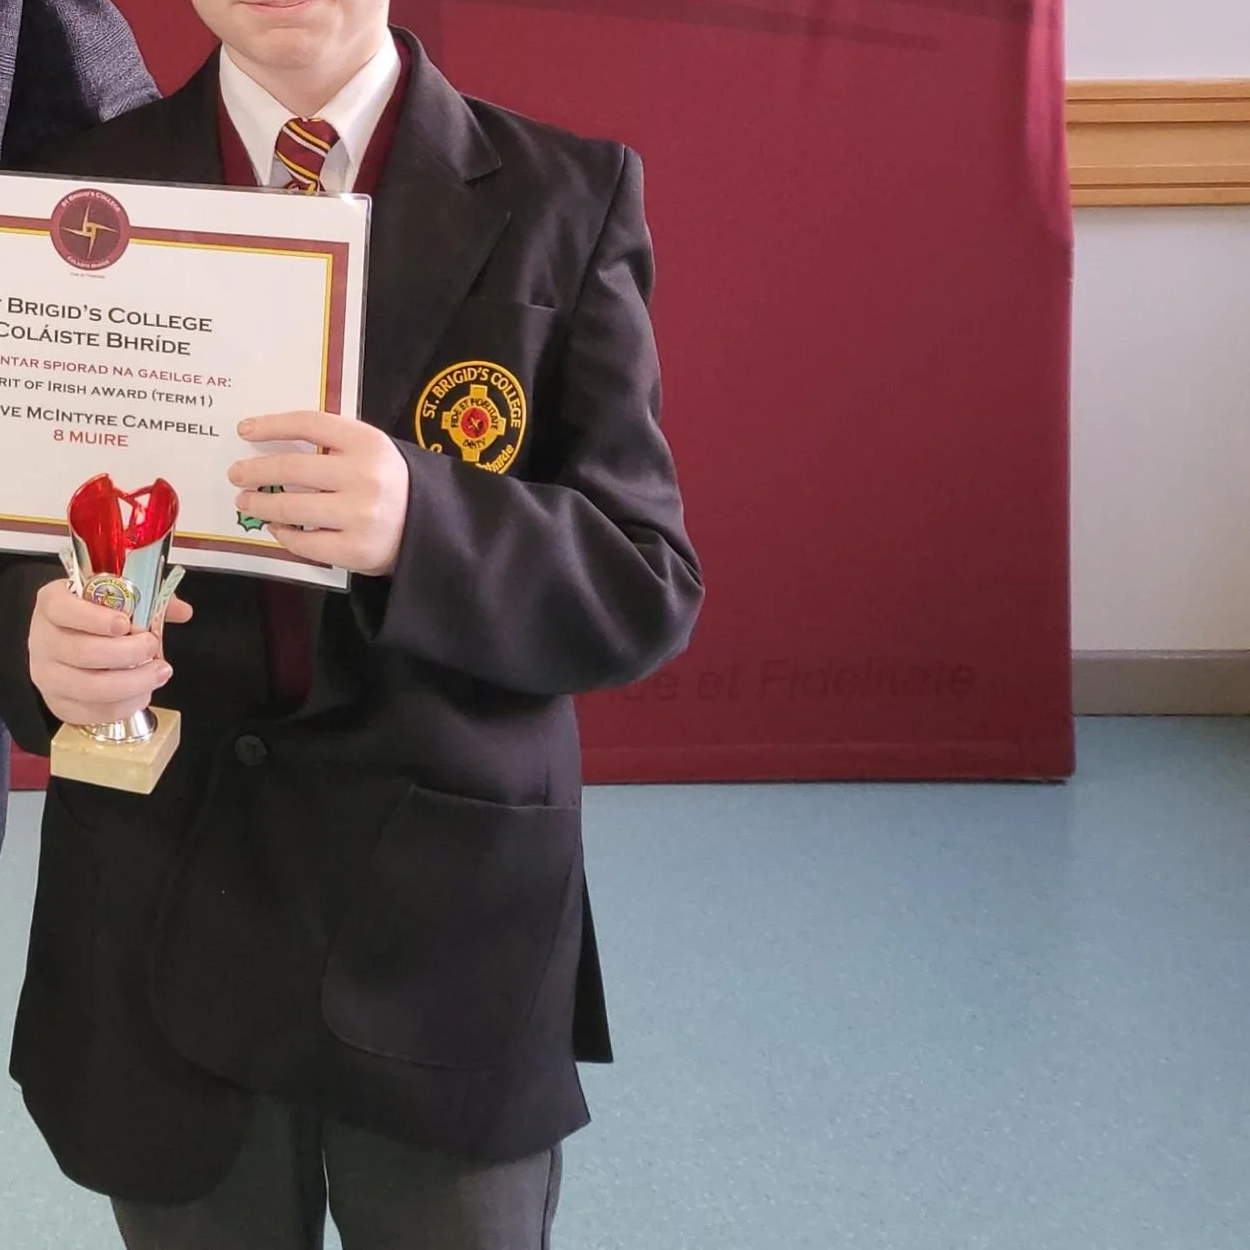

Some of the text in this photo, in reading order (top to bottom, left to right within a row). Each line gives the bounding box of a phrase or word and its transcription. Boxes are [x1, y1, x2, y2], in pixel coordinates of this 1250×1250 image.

[7, 297, 103, 322] BRIGID'S
[108, 307, 213, 333] COLLEGE
[106, 332, 192, 356] BHRÍDE
[43, 360, 109, 375] SPIORAD
[113, 366, 134, 378] NA
[138, 368, 203, 385] GAEILGE
[206, 376, 232, 388] AR:
[24, 379, 44, 390] OF
[48, 380, 87, 395] IRISH
[91, 386, 148, 400] AWARD
[422, 367, 522, 429] ST. BRIGID'S COLLEGE
[122, 414, 220, 437] CAMPBELL
[53, 429, 130, 447] 8 MUIRE
